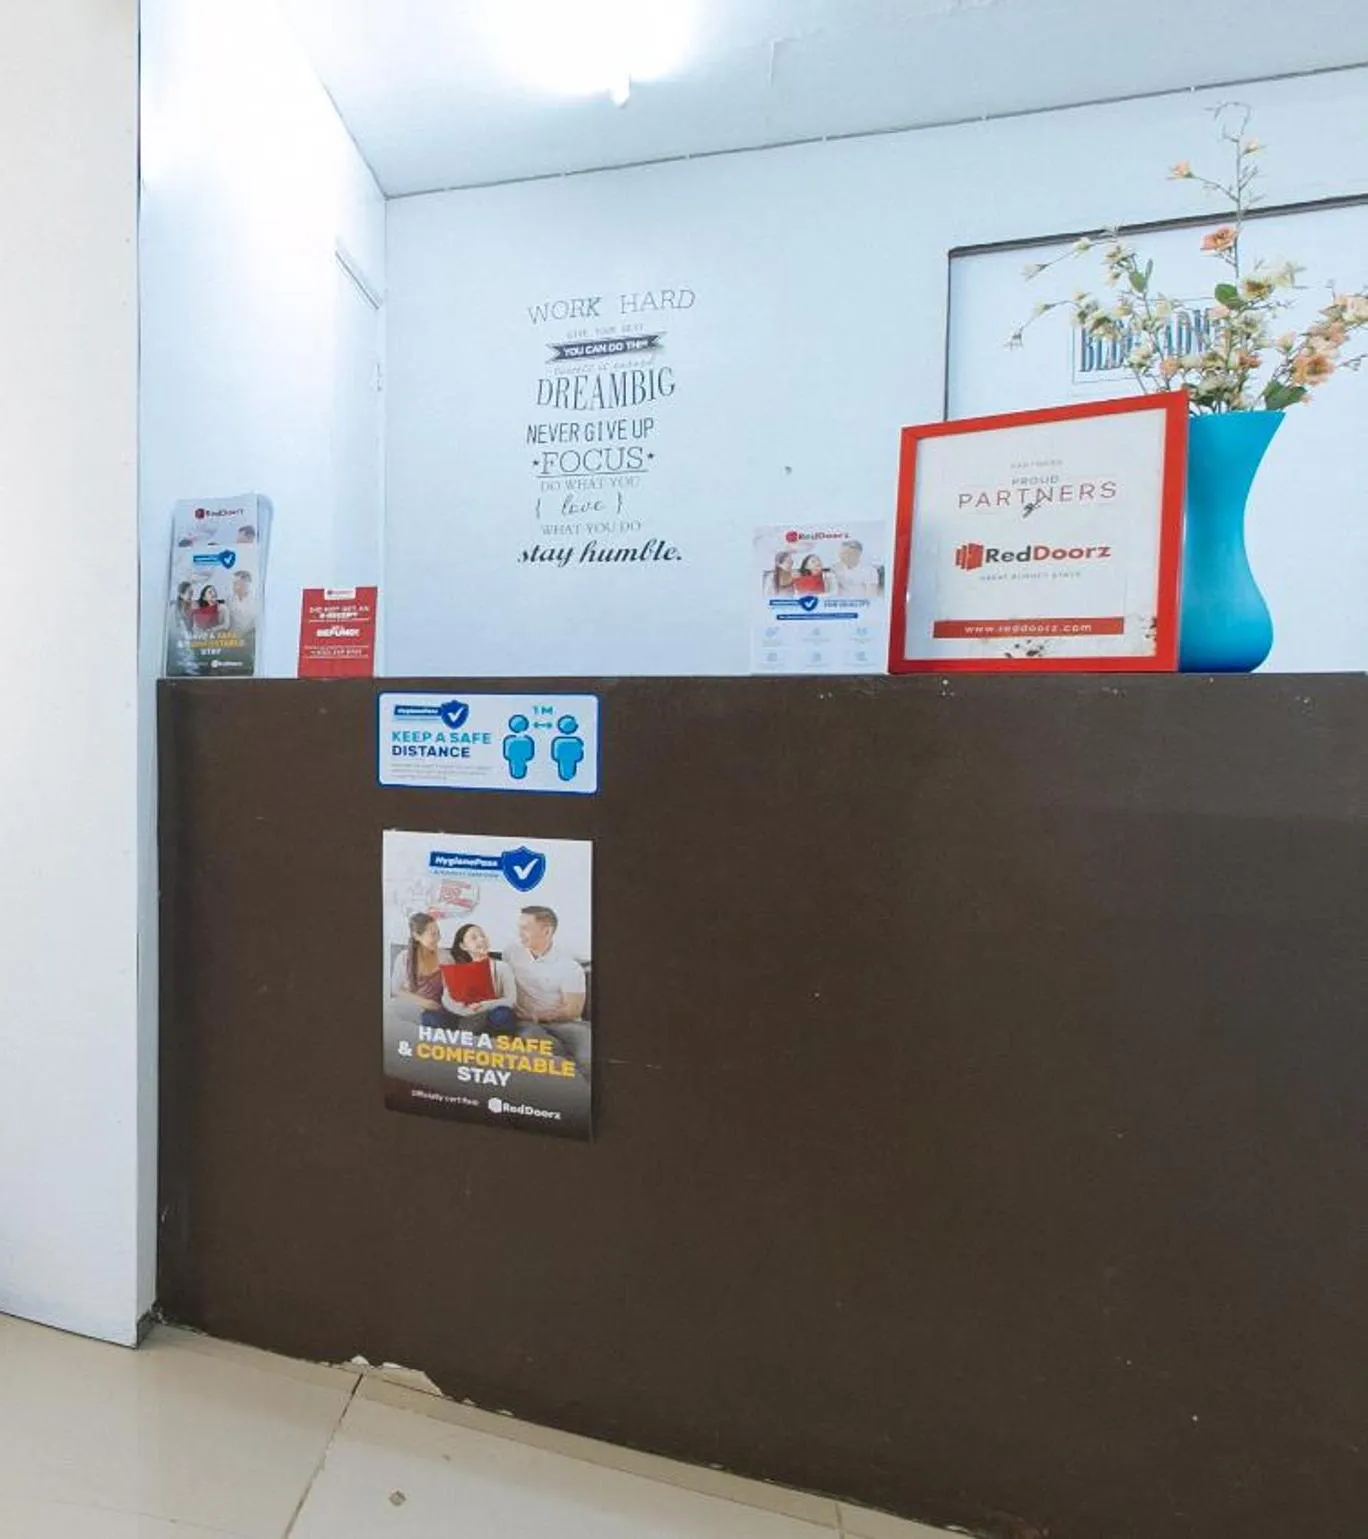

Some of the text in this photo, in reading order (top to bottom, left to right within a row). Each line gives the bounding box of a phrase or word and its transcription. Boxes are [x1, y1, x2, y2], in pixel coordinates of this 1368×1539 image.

[528, 289, 696, 325] WORK HARD
[563, 346, 584, 357] YOU
[585, 344, 607, 355] CAN
[608, 342, 624, 352] DO
[526, 417, 654, 444] NEVER GIVE UP
[541, 446, 644, 474] FOCUS
[541, 475, 641, 492] DO WHAT YOU
[1012, 475, 1059, 486] PROUD
[561, 493, 605, 515] love
[958, 481, 1117, 509] PARTNERS
[541, 519, 641, 536] WHAT YOU DO
[517, 538, 683, 568] stay humble.
[985, 545, 1111, 563] RedDoorz
[964, 623, 1092, 634] www.reddoorz.com
[541, 706, 554, 715] M
[392, 731, 492, 745] KEEP A SAFE
[392, 745, 471, 759] DISTANCE
[419, 1026, 554, 1056] HAVE A SAFE
[398, 1040, 577, 1078] & COMFORTABLE
[457, 1066, 511, 1087] STAY
[503, 1102, 562, 1121] RedDoorz
